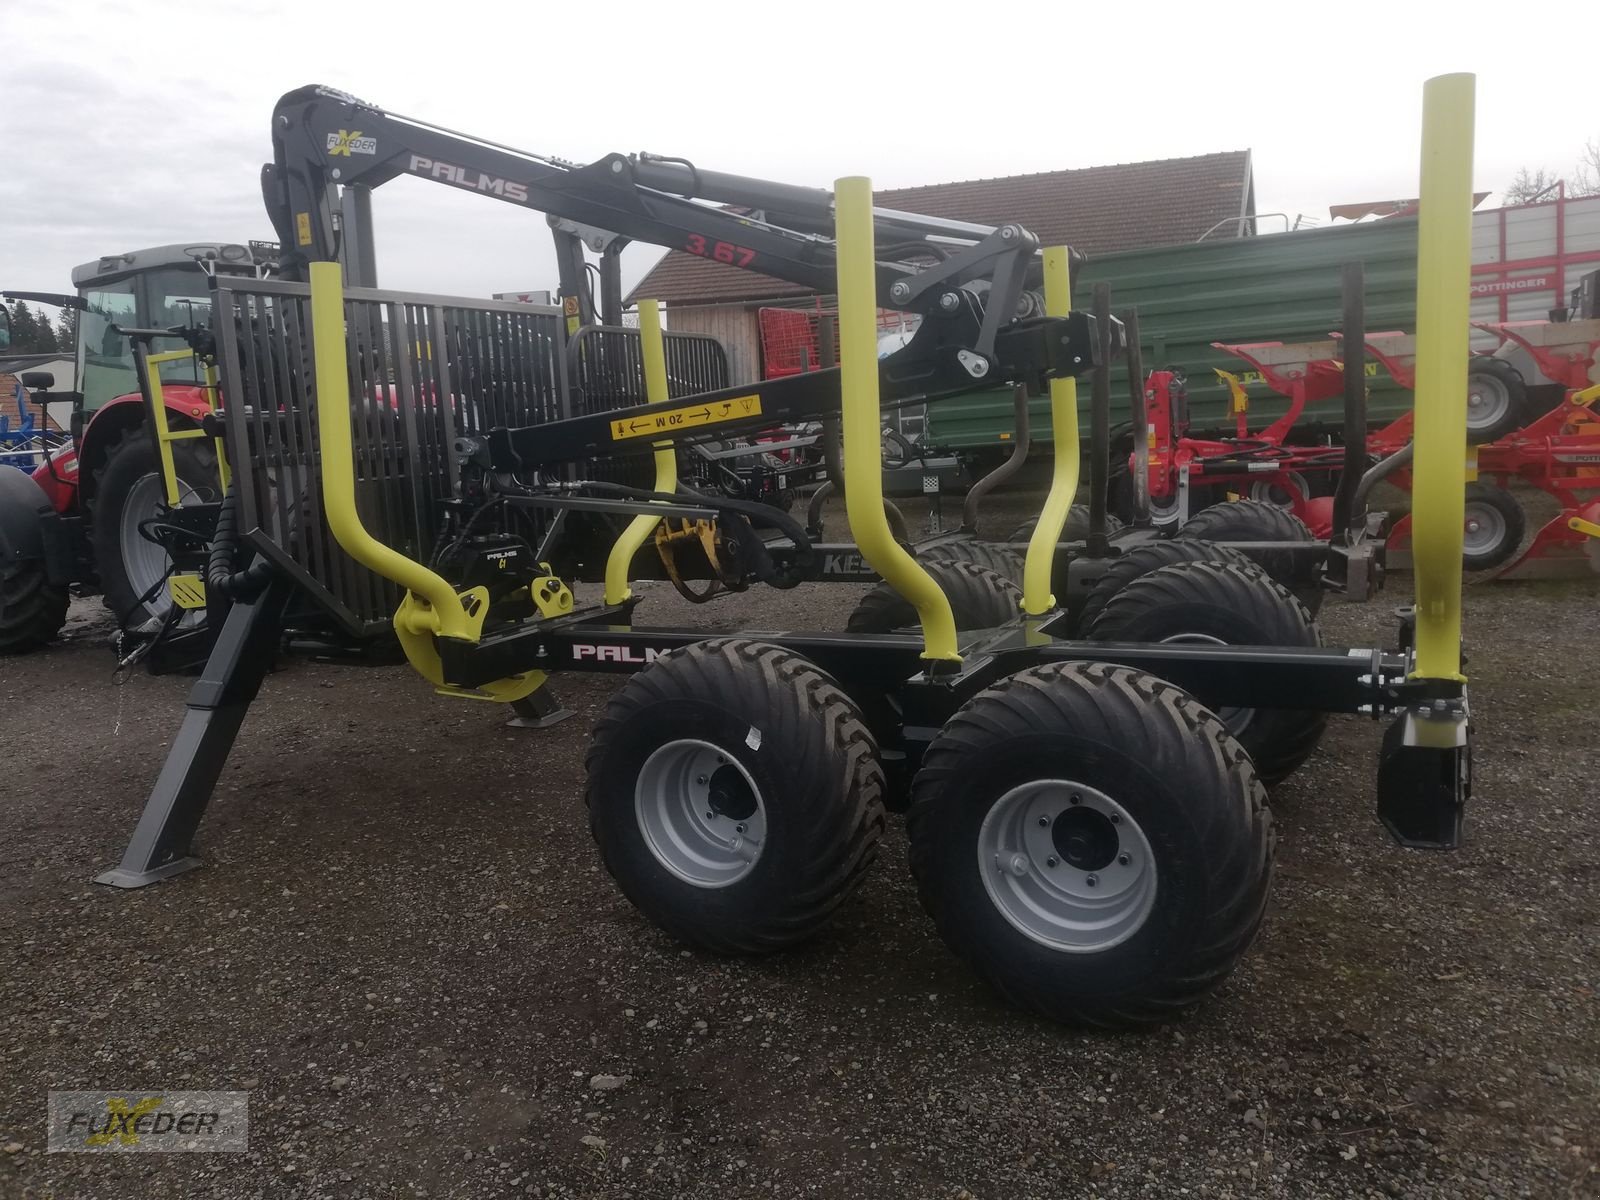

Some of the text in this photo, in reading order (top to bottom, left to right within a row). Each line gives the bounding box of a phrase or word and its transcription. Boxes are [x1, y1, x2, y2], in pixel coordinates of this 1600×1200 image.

[409, 155, 528, 201] PALMS
[686, 232, 758, 268] 3.67
[656, 414, 683, 427] 20 M
[487, 551, 517, 560] PALMS
